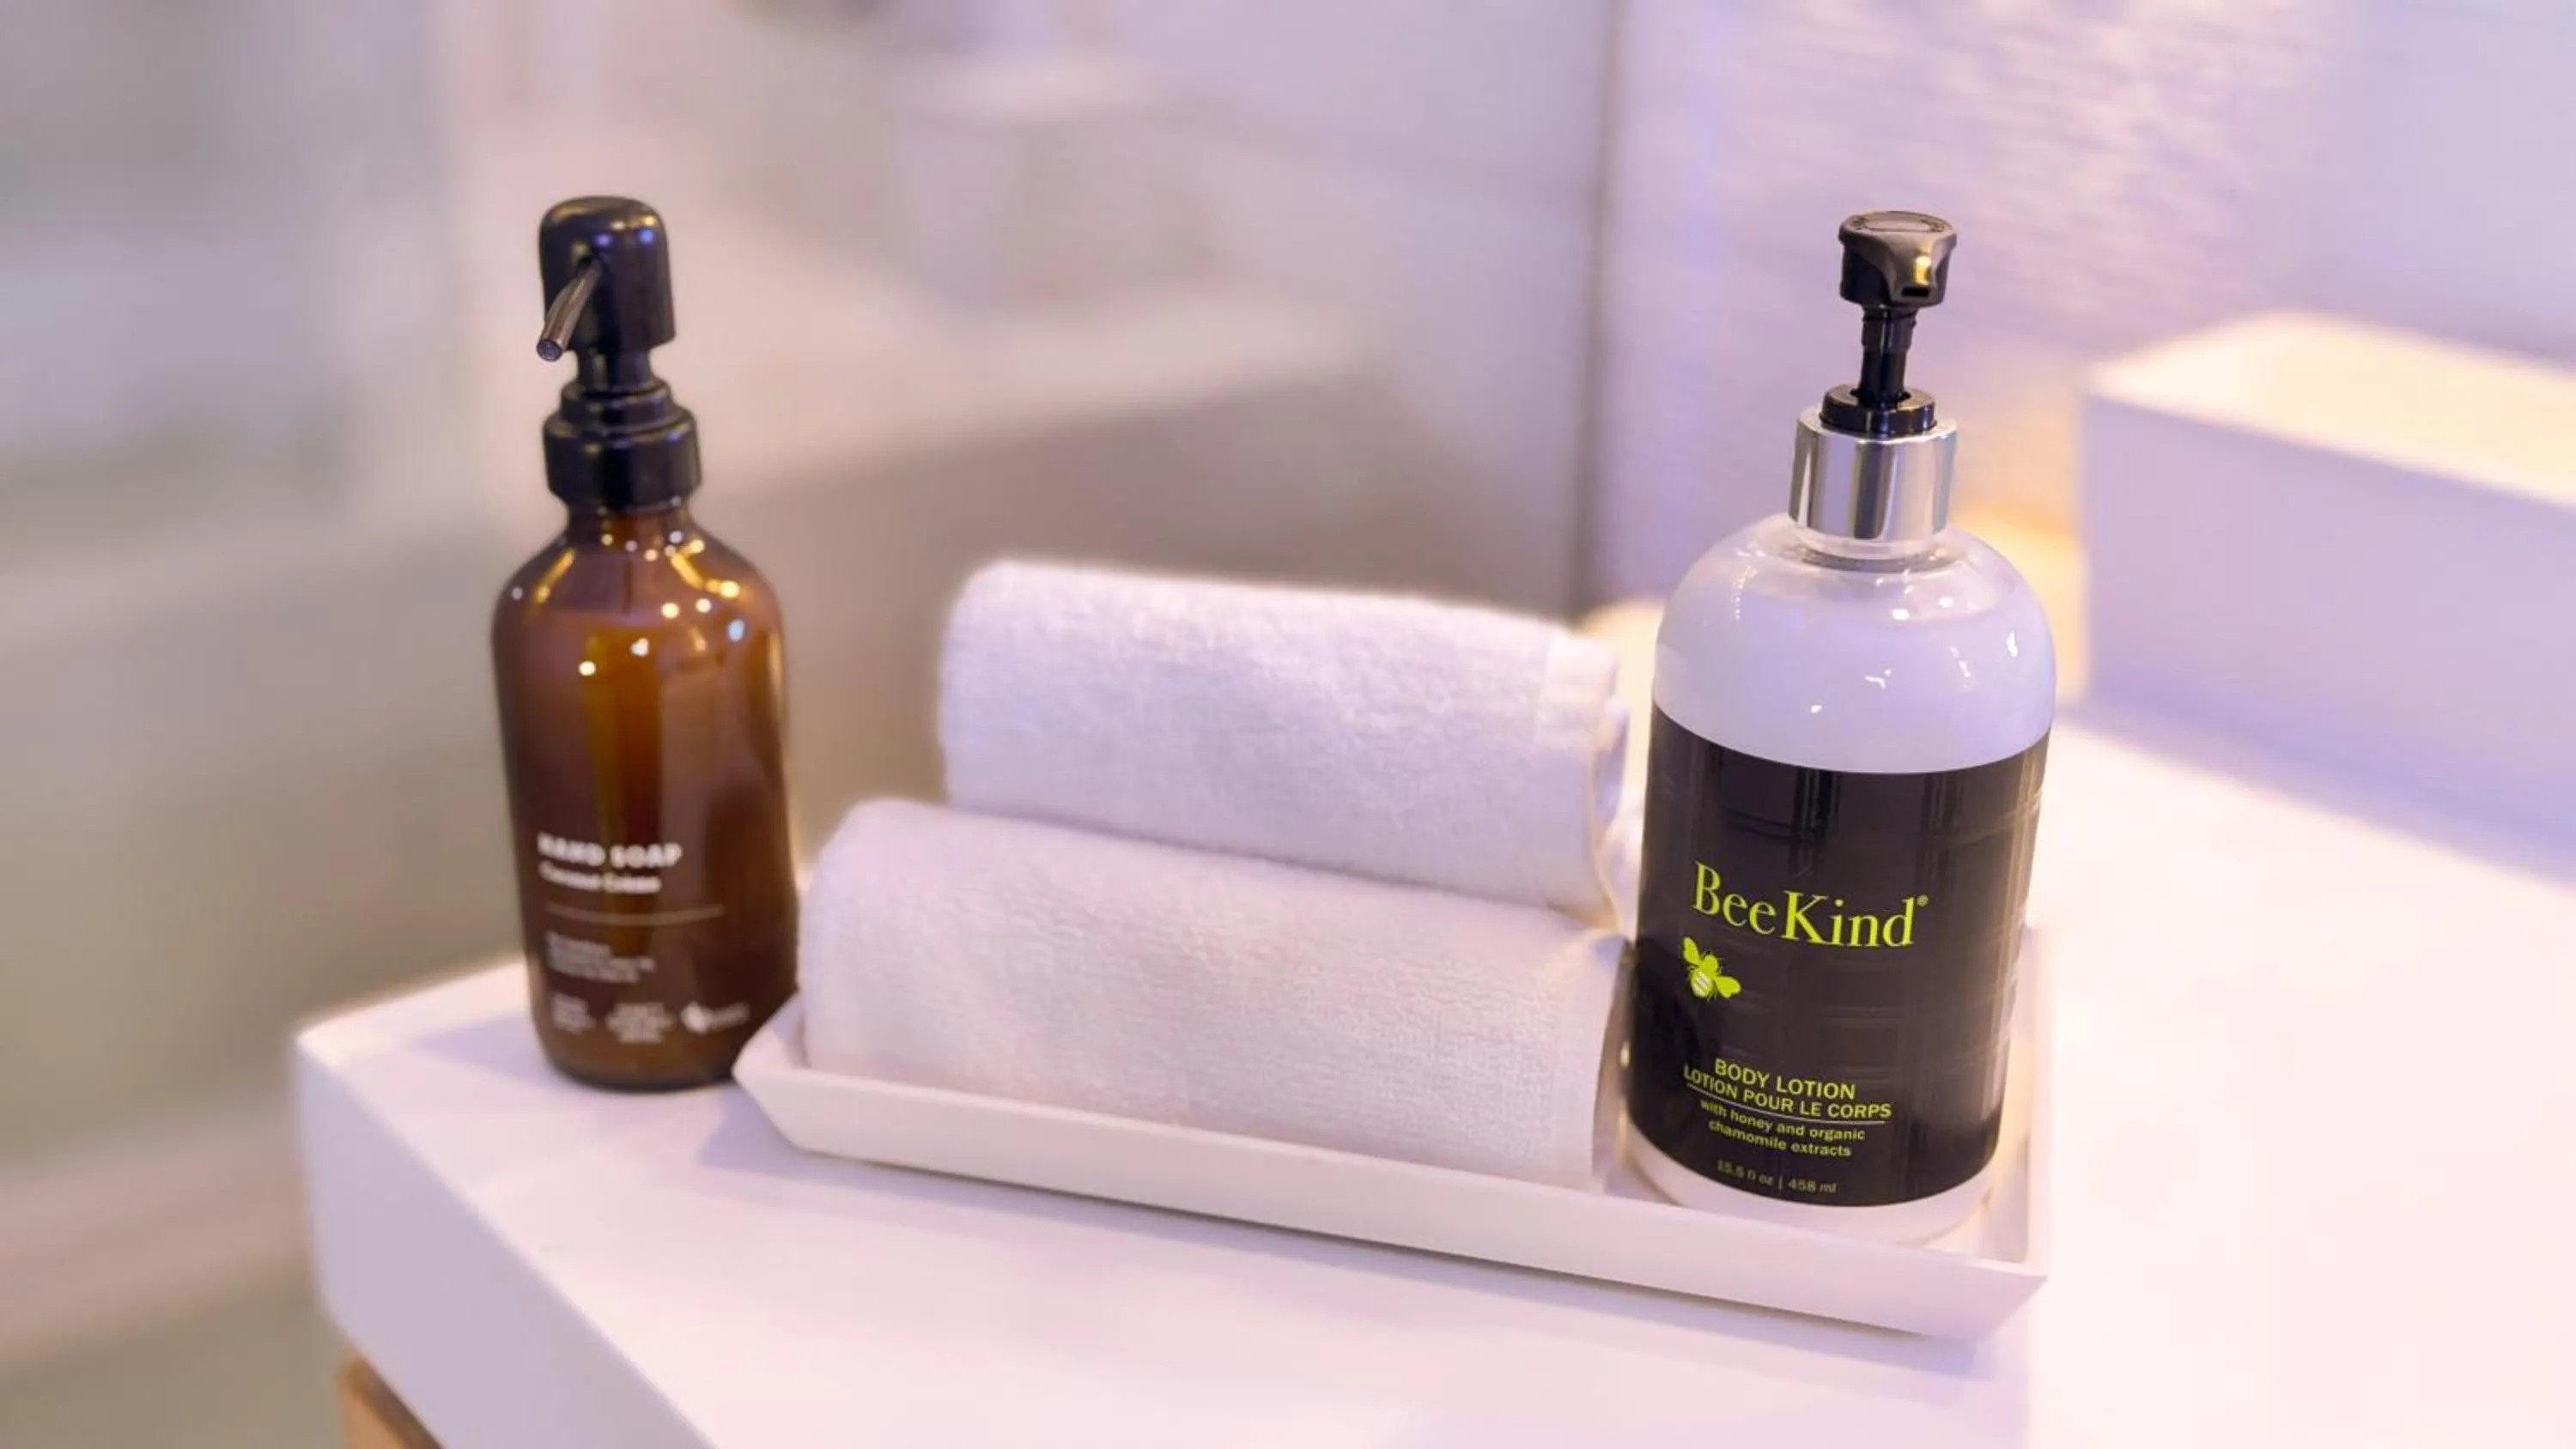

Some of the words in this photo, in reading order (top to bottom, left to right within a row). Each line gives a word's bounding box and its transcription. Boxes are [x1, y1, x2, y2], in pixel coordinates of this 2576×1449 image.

[610, 842, 683, 869] SOAP
[1683, 1064, 1738, 1099] LOTION
[1743, 1088, 1794, 1113] POUR
[1799, 1101, 1822, 1118] LE
[1827, 1103, 1893, 1119] CORPS
[1715, 1058, 1770, 1088] BODY
[1776, 1076, 1856, 1100] LOTION
[1700, 1099, 1728, 1118] with
[1730, 1107, 1773, 1133] honey
[1777, 1122, 1805, 1137] and
[1809, 1127, 1866, 1143] organic
[1708, 1119, 1788, 1151] chamomile
[1790, 1140, 1852, 1157] extracts
